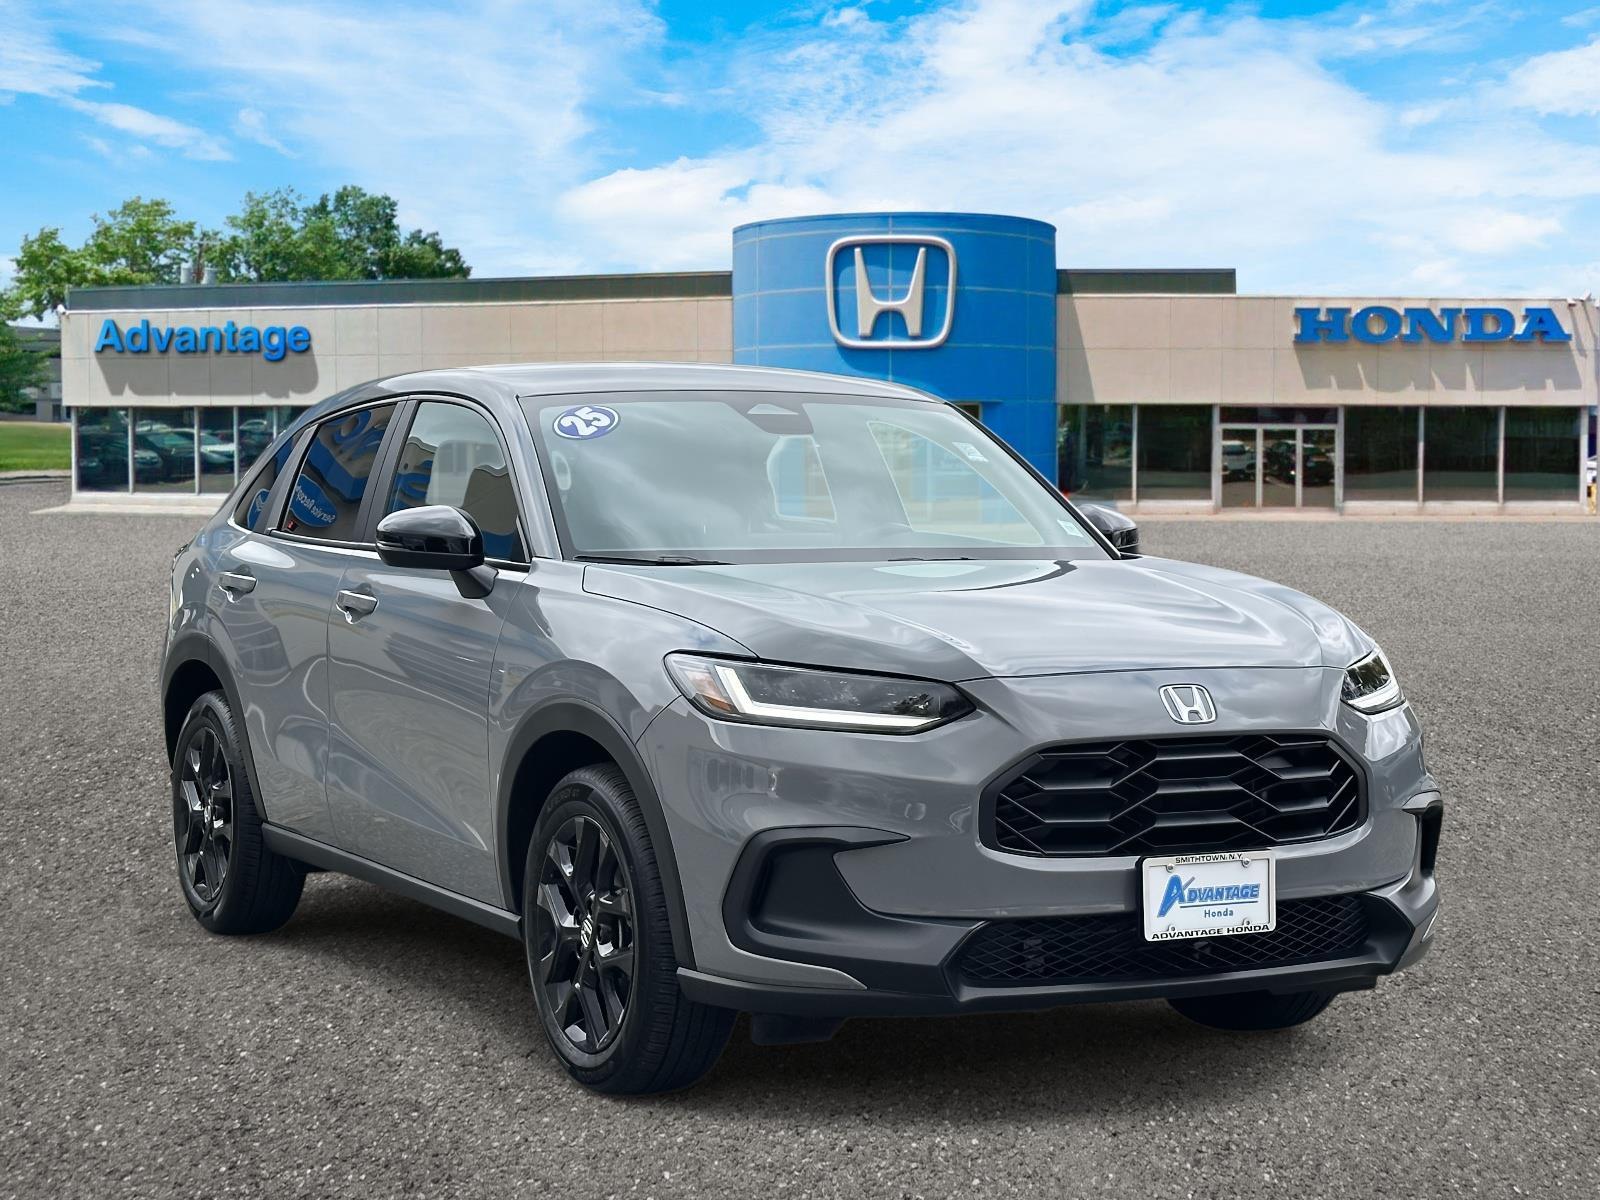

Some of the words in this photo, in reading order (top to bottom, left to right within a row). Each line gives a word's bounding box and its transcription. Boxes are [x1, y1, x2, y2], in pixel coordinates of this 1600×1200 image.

[95, 319, 312, 362] Advantage
[1294, 305, 1572, 344] HONDA
[560, 406, 611, 436] 25
[1157, 875, 1260, 918] ADVANTAGE
[1204, 907, 1234, 918] Honda
[1151, 927, 1223, 940] ADVANTAGE
[1226, 924, 1270, 935] HONDA
